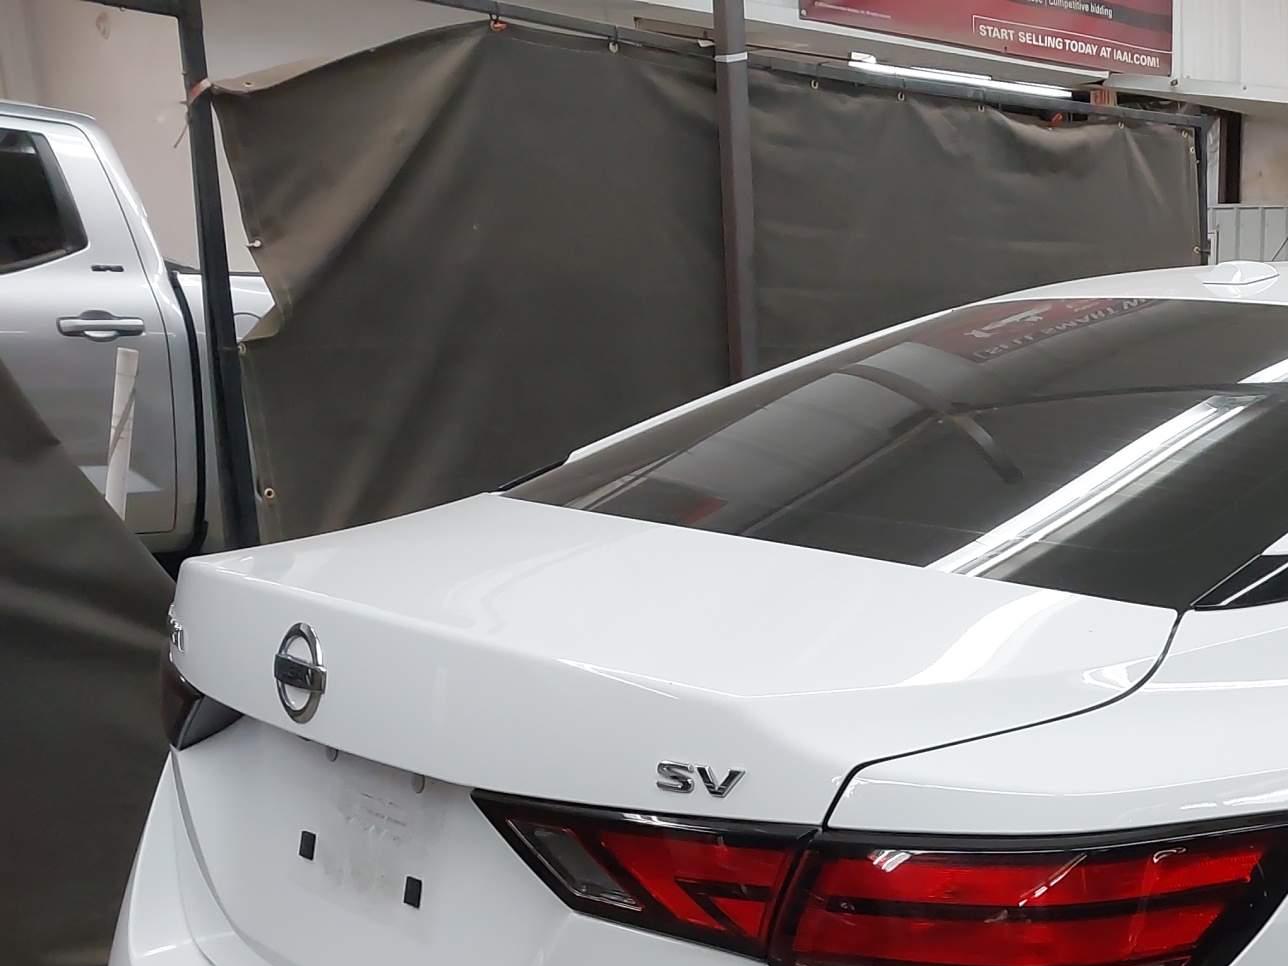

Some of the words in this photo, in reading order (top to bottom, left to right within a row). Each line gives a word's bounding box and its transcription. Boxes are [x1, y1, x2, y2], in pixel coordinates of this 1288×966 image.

[1090, 3, 1113, 18] bidding
[979, 25, 1015, 41] START
[1018, 31, 1063, 50] SELLING
[1064, 40, 1098, 56] TODAY
[1099, 47, 1112, 60] AT
[1113, 49, 1160, 68] IAAI.COM!
[656, 760, 745, 798] SV
